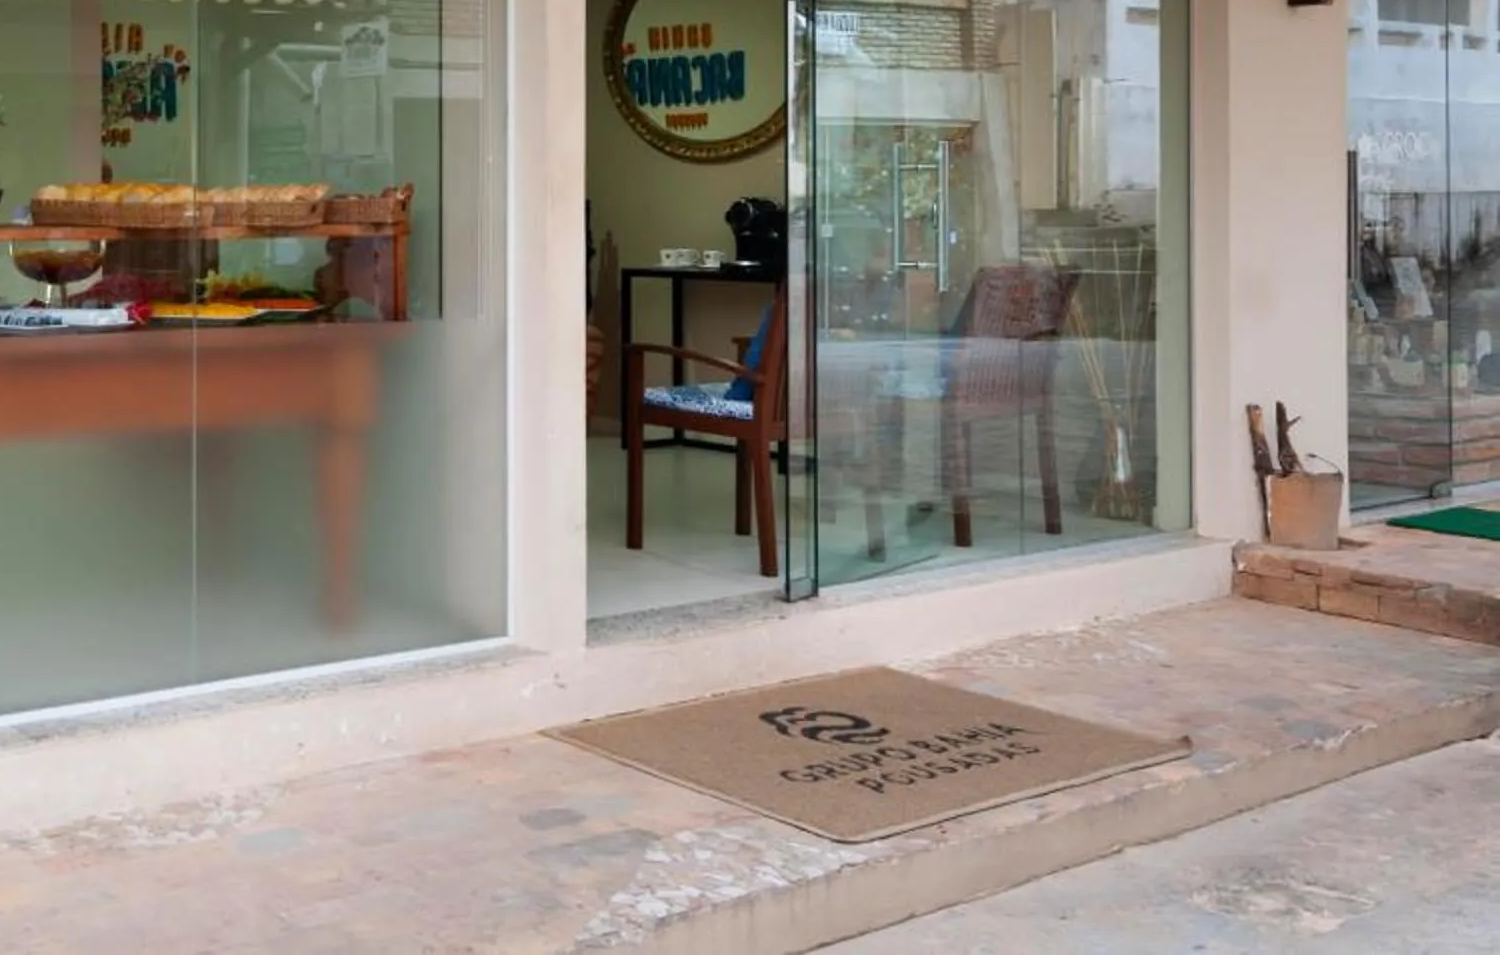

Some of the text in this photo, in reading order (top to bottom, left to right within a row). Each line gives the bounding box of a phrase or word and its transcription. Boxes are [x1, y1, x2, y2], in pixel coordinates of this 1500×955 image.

[779, 721, 1026, 783] GRUPO BAHIA
[856, 741, 1042, 794] POUSADAS
